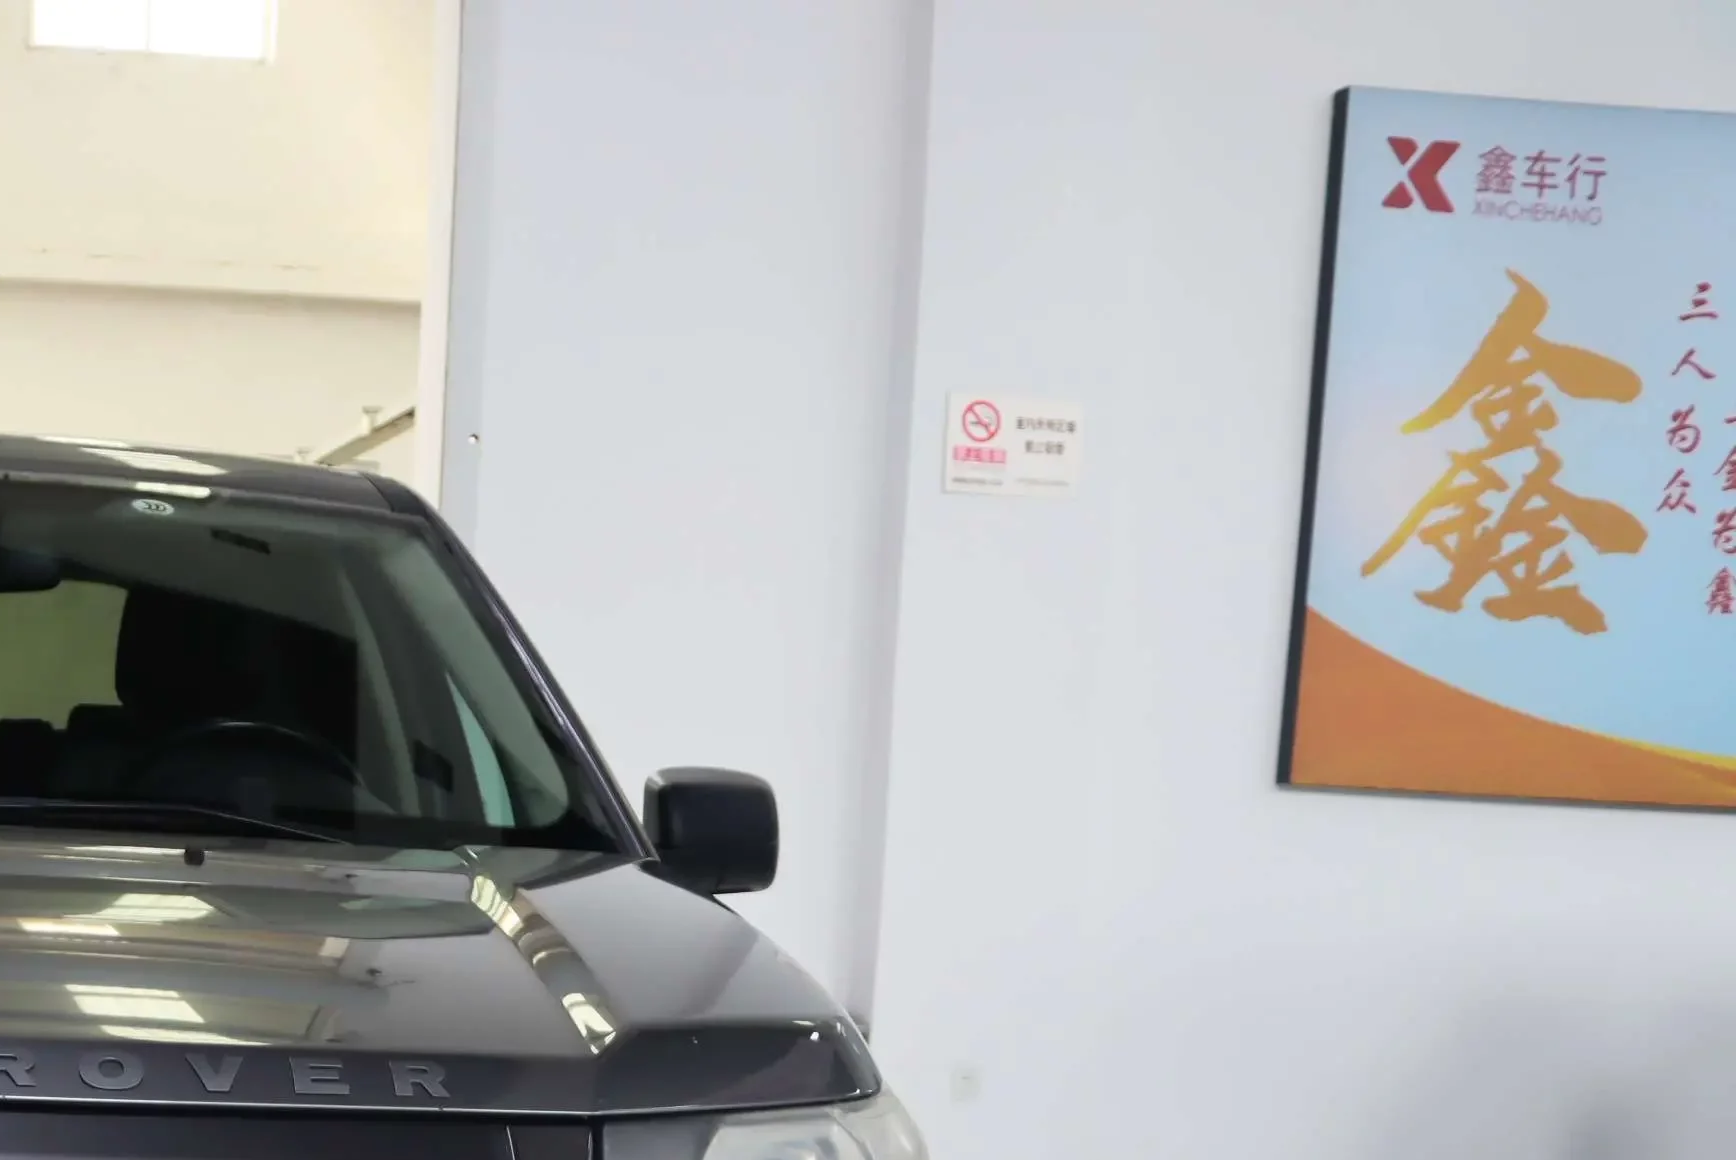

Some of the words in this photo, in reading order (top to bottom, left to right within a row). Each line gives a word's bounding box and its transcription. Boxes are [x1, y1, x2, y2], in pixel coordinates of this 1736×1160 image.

[1472, 200, 1603, 226] XINCHEHANG
[1476, 145, 1607, 201] 鑫车行
[1360, 266, 1648, 635] 鑫
[1656, 281, 1719, 514] 三人为众
